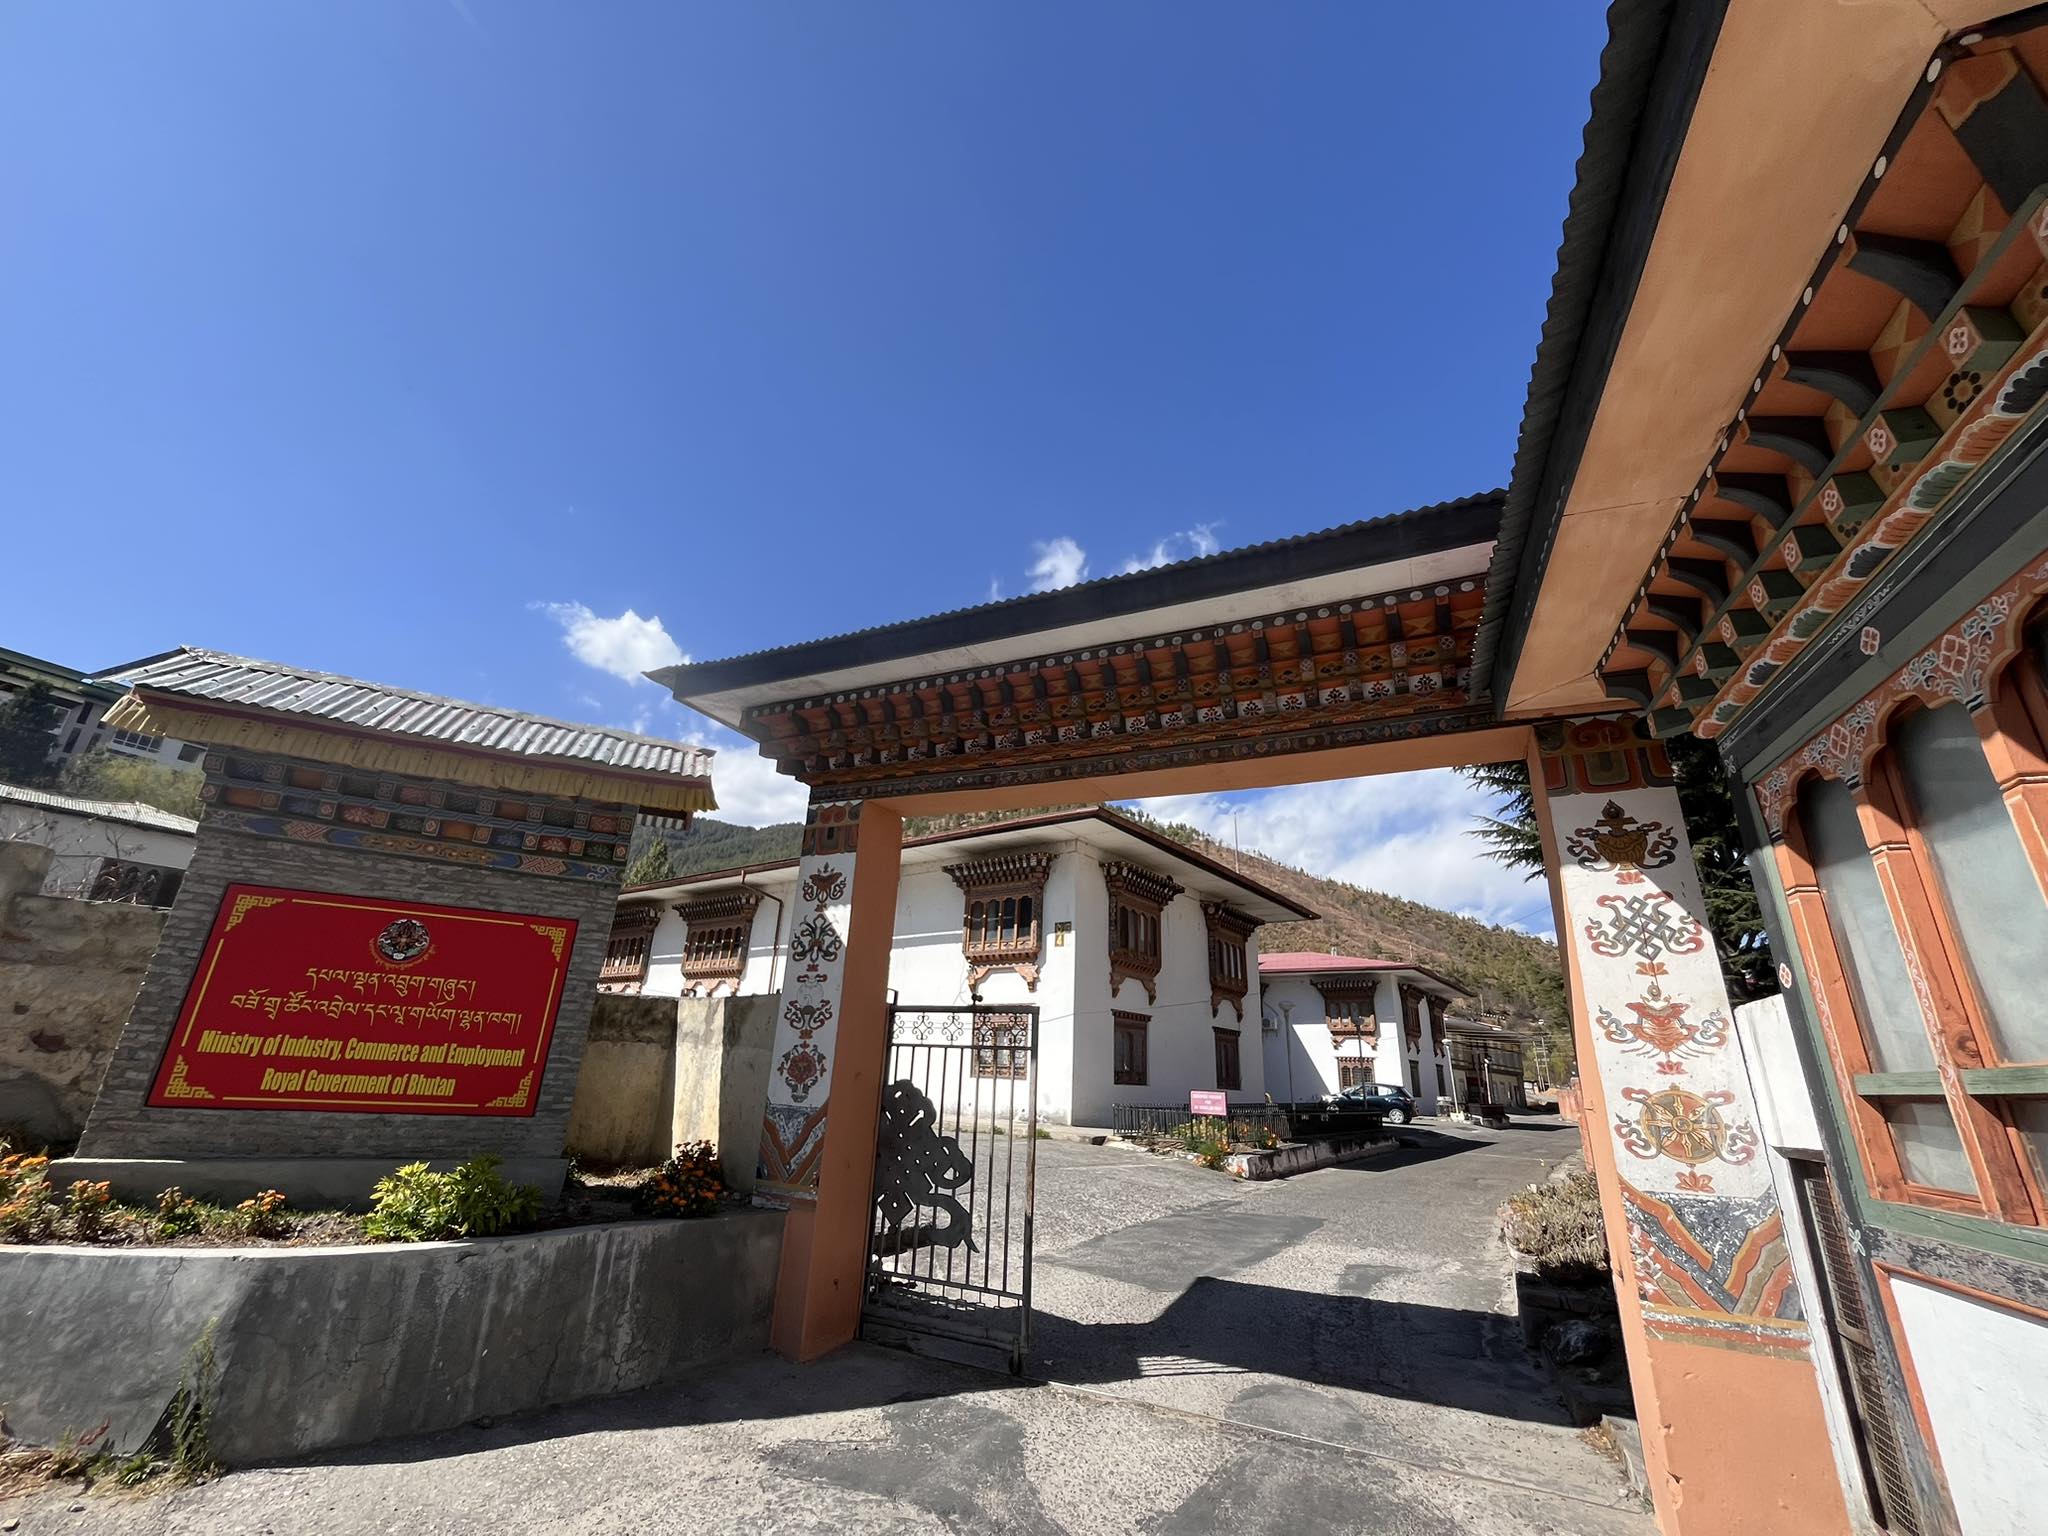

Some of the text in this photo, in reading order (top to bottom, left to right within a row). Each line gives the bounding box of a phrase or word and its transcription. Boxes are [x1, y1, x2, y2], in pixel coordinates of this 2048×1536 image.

[197, 1030, 525, 1068] Ministry of Industry, Commerce and Employment
[260, 1067, 456, 1097] Royal Government of Bhutan
